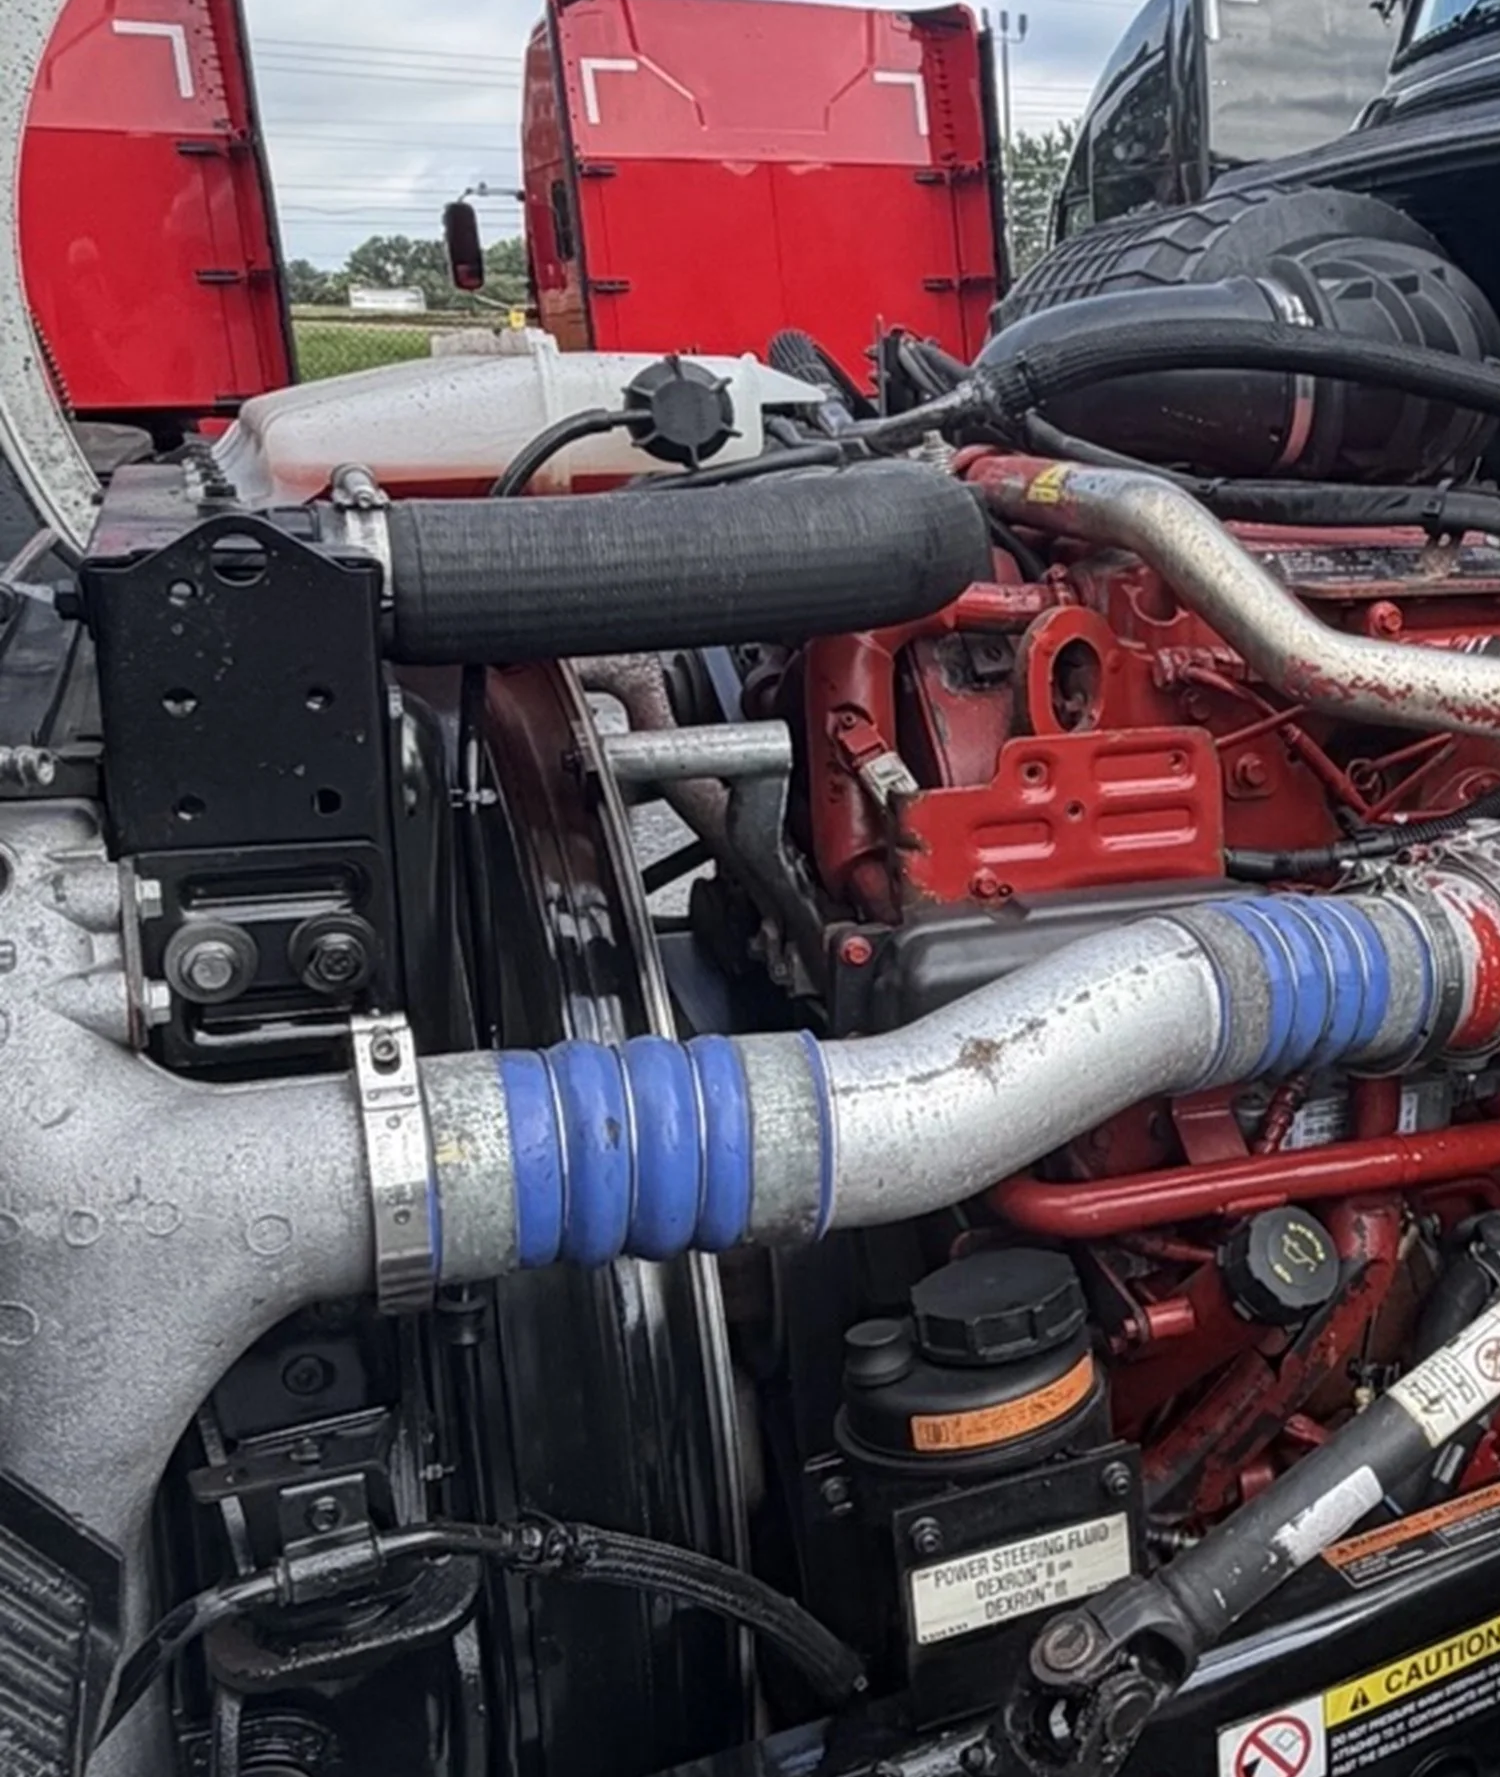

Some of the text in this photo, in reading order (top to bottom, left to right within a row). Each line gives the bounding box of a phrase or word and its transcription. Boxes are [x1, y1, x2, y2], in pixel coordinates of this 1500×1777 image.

[933, 1522, 1110, 1588] POWER STEERING FLUID
